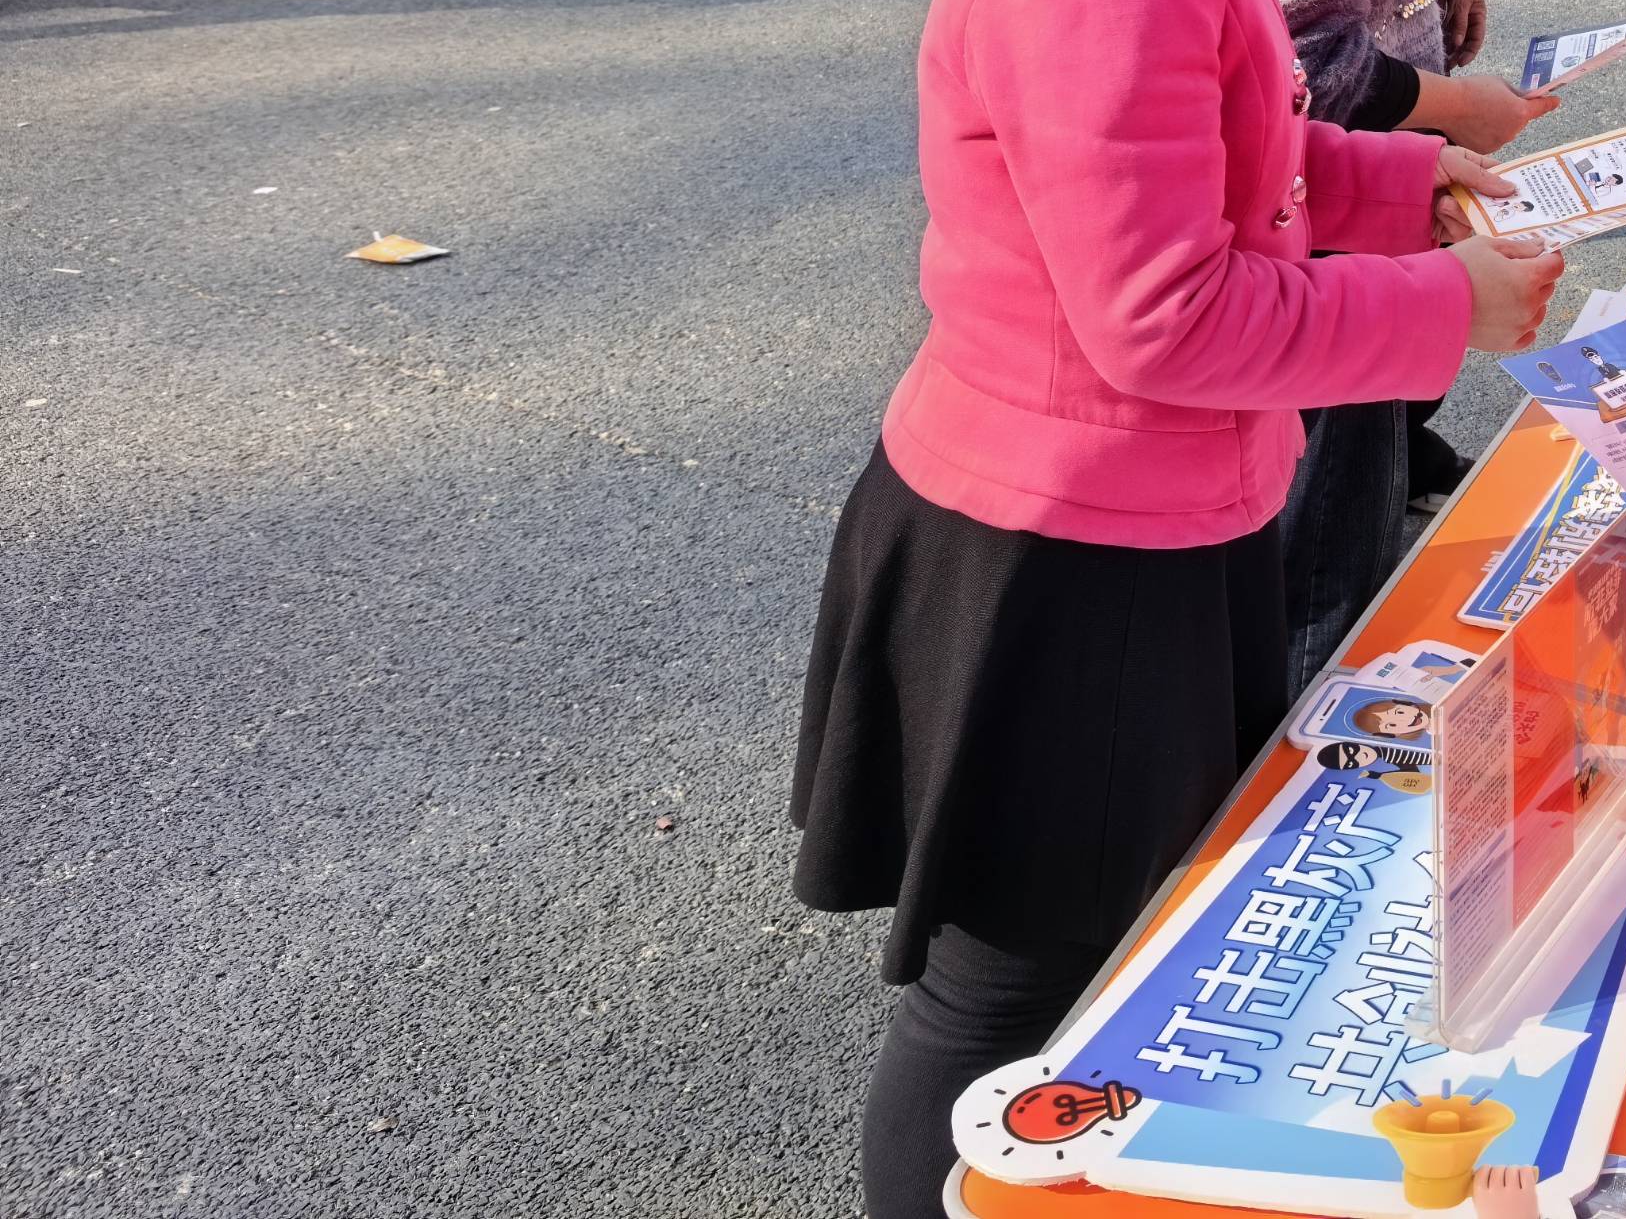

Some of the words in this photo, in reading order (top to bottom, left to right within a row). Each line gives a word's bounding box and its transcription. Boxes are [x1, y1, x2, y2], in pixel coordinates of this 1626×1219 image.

[1135, 781, 1403, 1085] 打击黑灰产
